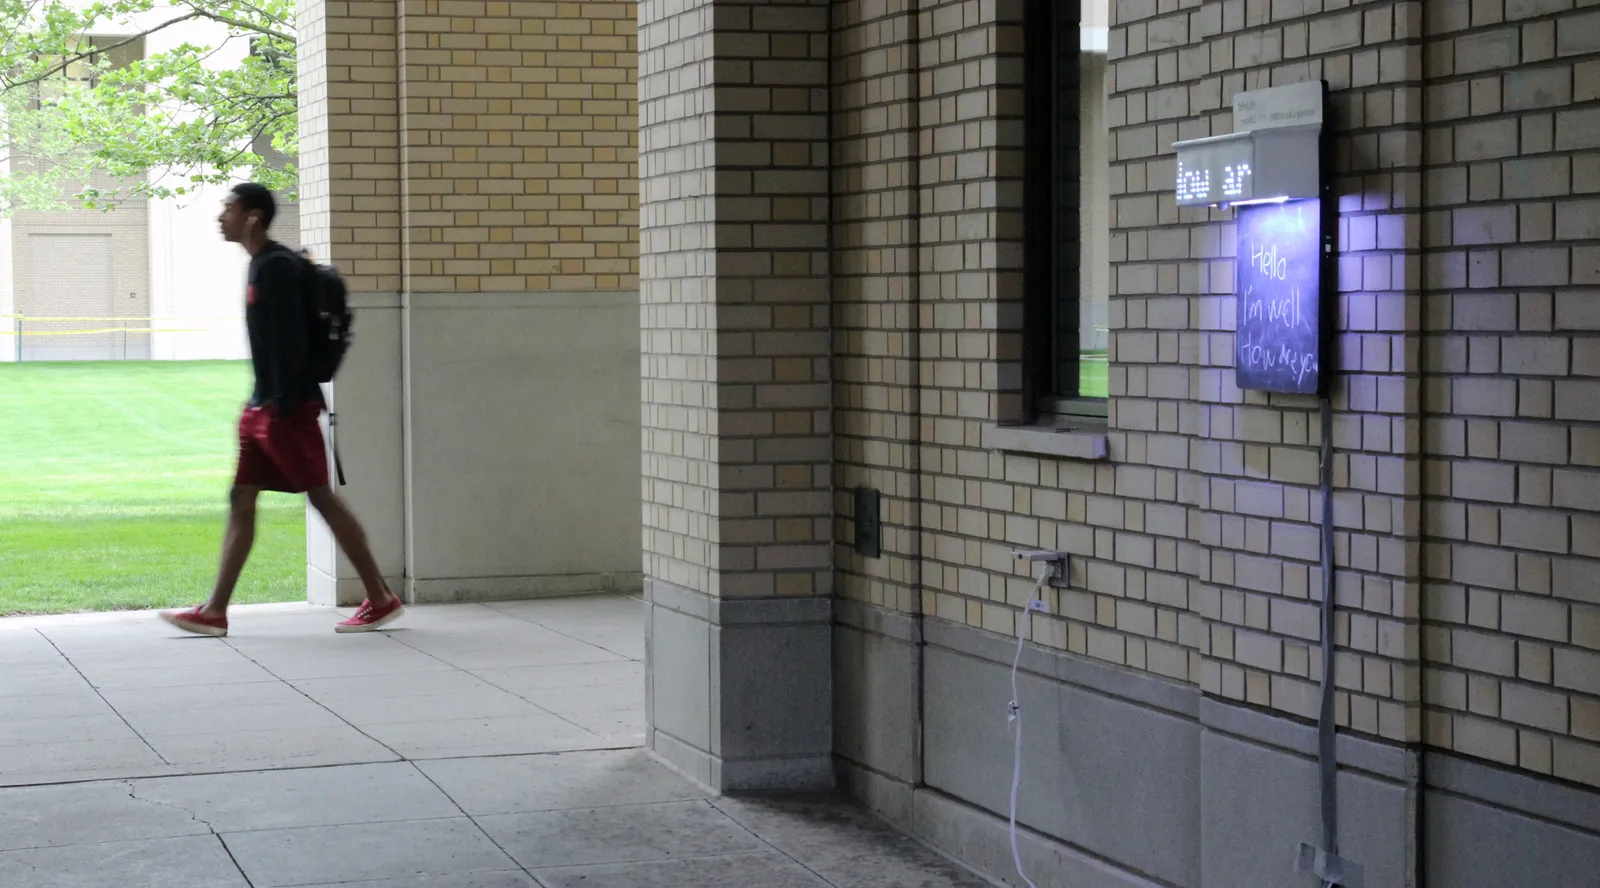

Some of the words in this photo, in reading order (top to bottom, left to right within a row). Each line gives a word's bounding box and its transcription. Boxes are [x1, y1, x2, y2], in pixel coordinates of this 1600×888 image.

[1251, 242, 1287, 280] Hello
[1243, 284, 1263, 326] I'm
[1267, 283, 1300, 329] well
[1241, 331, 1276, 371] How
